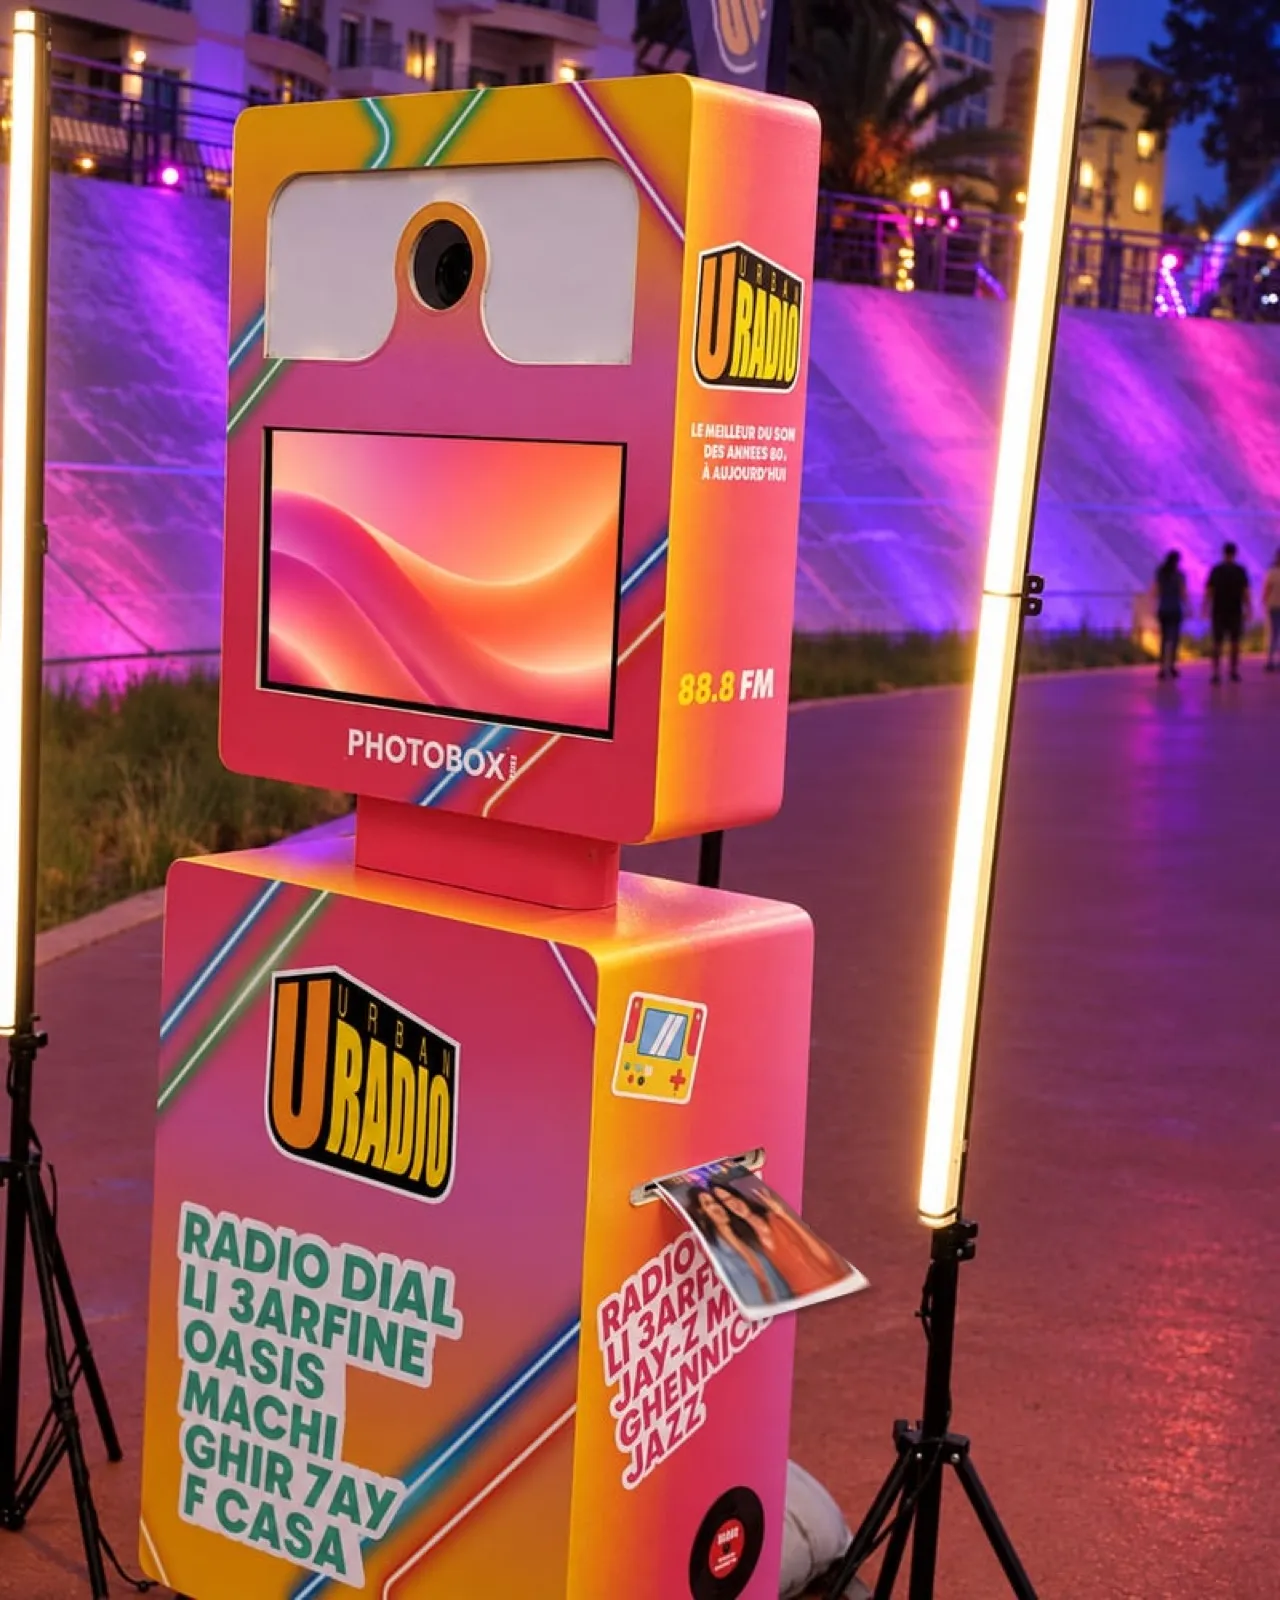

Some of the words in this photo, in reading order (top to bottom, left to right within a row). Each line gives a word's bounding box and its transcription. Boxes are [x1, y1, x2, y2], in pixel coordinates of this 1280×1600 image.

[691, 422, 704, 438] LE
[705, 424, 756, 440] MEILLEUR
[757, 426, 772, 441] DU
[774, 427, 796, 442] SON
[703, 444, 724, 459] DES
[712, 466, 787, 482] AUJOURD'HUI
[678, 670, 735, 706] 88.8
[739, 668, 774, 701] FM
[348, 728, 505, 781] PHOTOBOX
[337, 984, 451, 1078] URBAN
[183, 1211, 330, 1289] RADIO
[342, 1253, 456, 1329] DIAL
[602, 1238, 695, 1342] RADIO
[184, 1265, 218, 1313] LI
[229, 1278, 428, 1377] 3ARFINE
[184, 1319, 326, 1399] OASIS
[606, 1330, 630, 1378] LI
[616, 1311, 699, 1412] JAY-Z
[183, 1371, 338, 1460] MACHI
[627, 1393, 701, 1484] JAZZ
[184, 1424, 294, 1500] GHIR
[305, 1466, 397, 1531] 7AY
[184, 1474, 208, 1516] F
[216, 1488, 347, 1575] CASA
